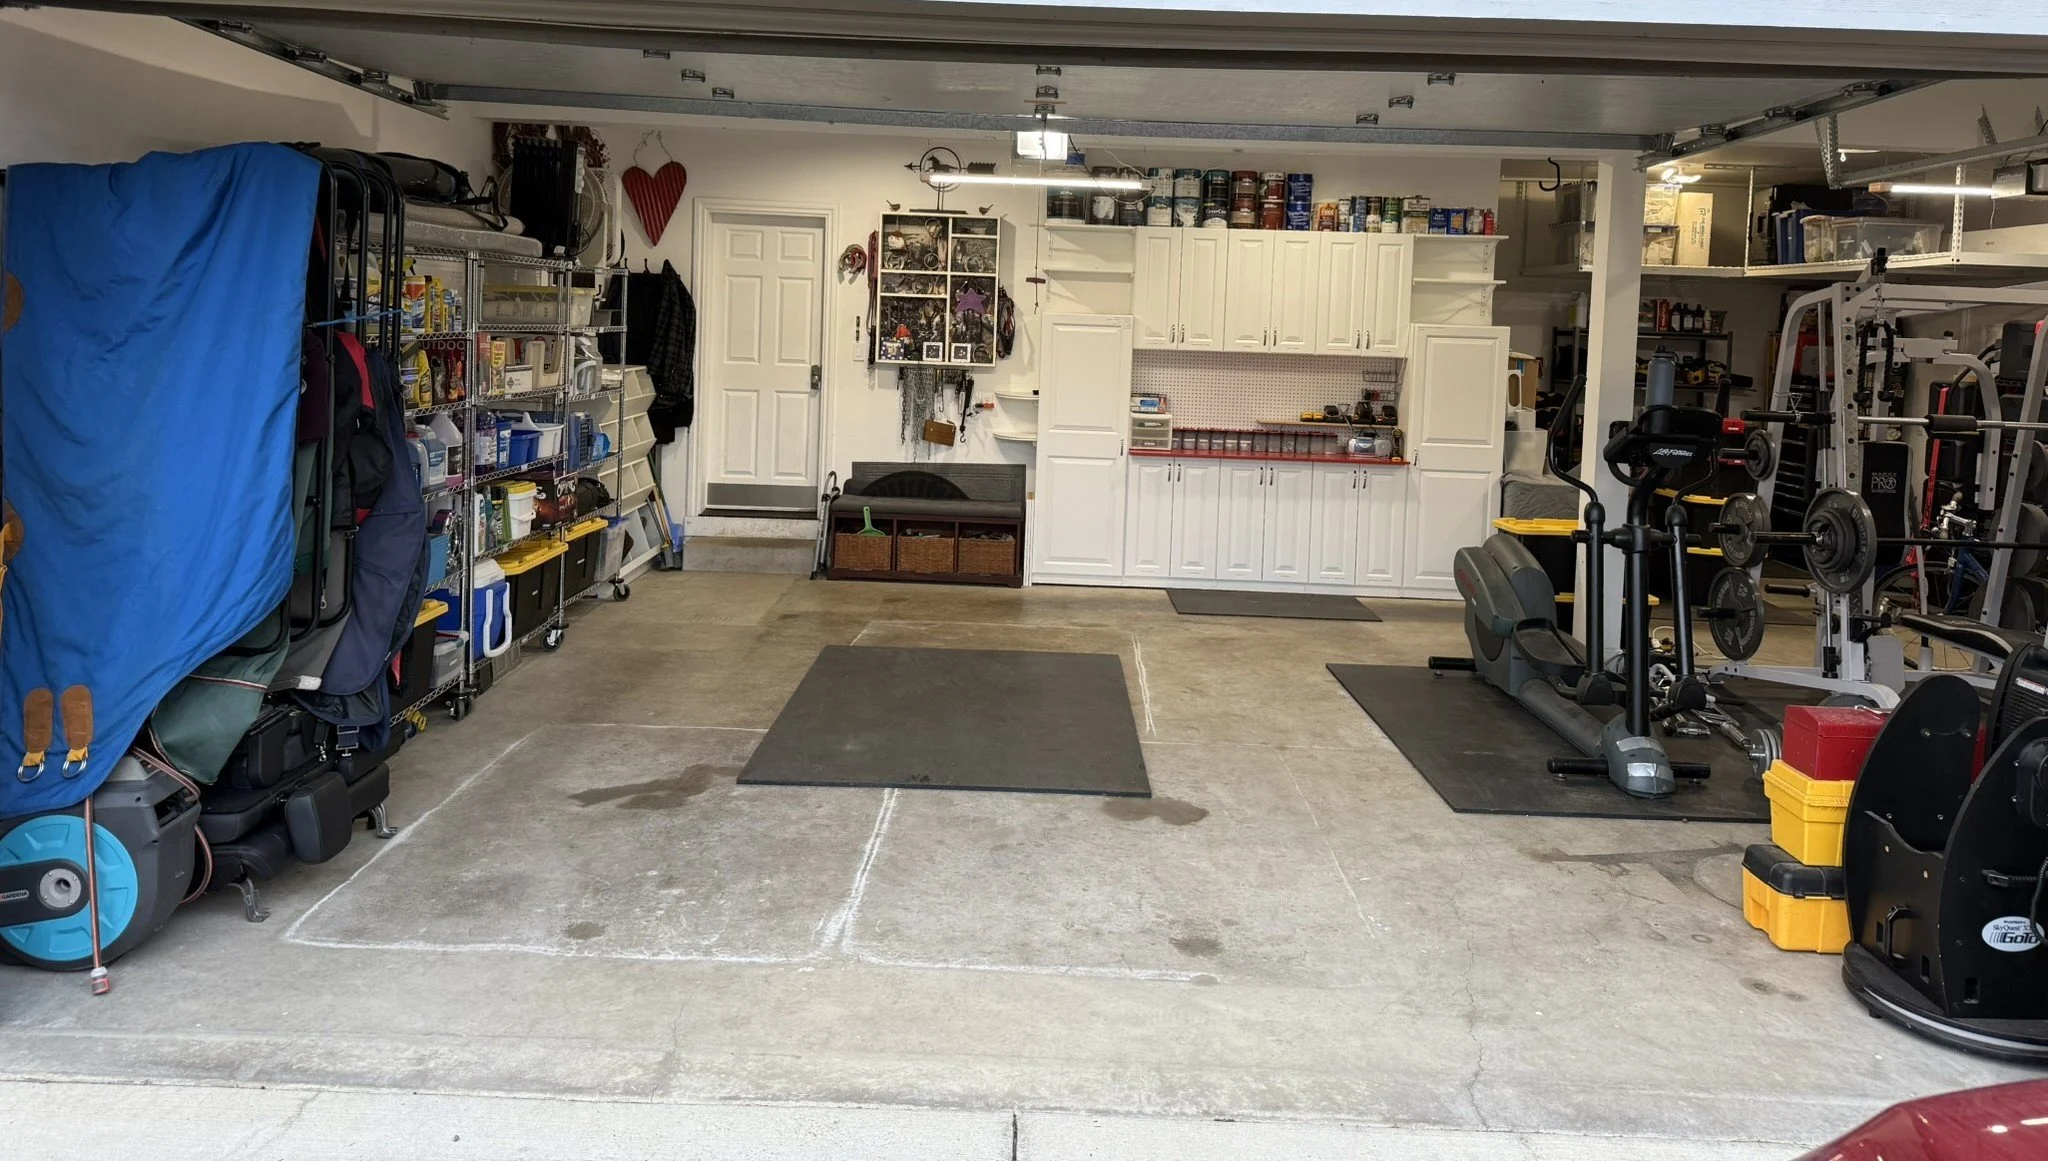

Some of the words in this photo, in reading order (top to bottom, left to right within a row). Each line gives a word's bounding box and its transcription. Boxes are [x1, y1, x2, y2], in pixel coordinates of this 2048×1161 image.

[1871, 476, 1897, 490] PRO
[1, 891, 28, 900] GARDENA
[2002, 932, 2038, 944] GoTo
